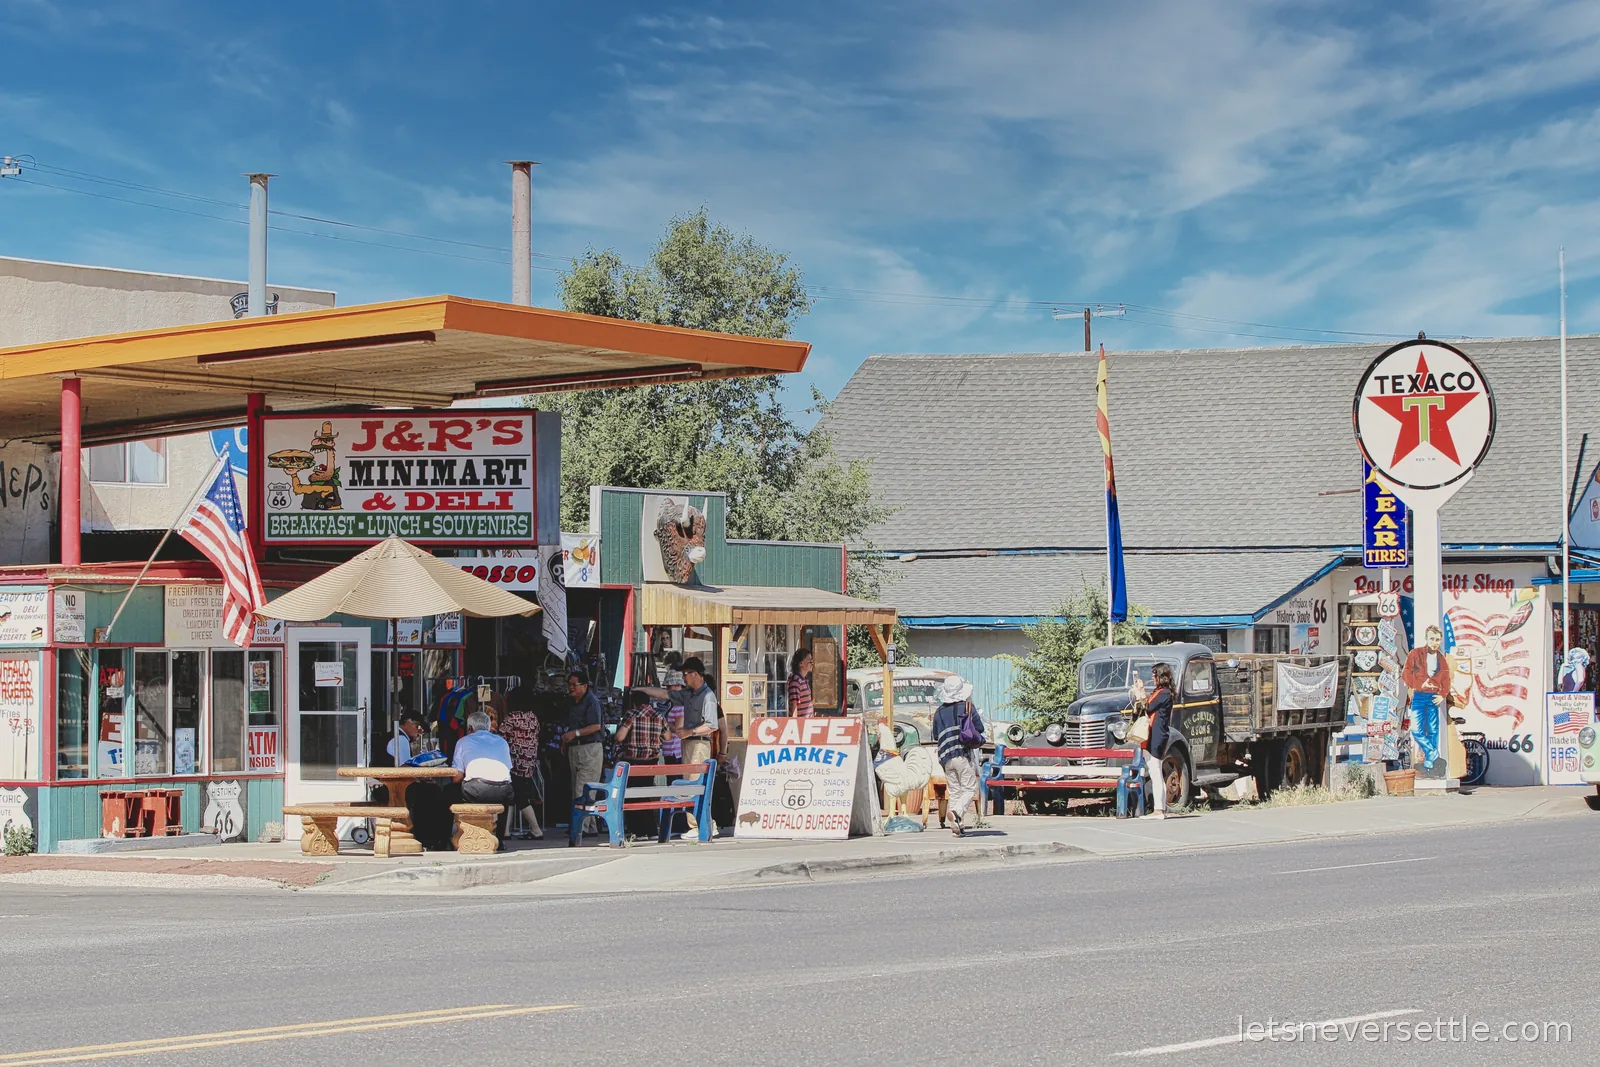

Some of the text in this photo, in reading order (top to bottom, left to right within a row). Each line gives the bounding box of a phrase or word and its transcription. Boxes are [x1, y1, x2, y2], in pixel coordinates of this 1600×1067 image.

[1374, 371, 1475, 394] TEXACO
[352, 419, 525, 452] J&R'S
[349, 458, 528, 487] MINIMART
[272, 496, 286, 506] 66
[362, 491, 514, 511] & DELI
[270, 515, 529, 536] BREAKFAST LUNCH SOUVENIRS
[1366, 549, 1406, 562] TIRES
[168, 587, 190, 596] FRESH
[190, 586, 212, 596] FRUITS
[1474, 574, 1514, 598] Shop
[22, 592, 32, 602] TO
[34, 592, 45, 602] GO
[66, 594, 76, 606] NO
[190, 598, 208, 606] FRESH
[211, 598, 224, 606] EGG
[22, 606, 38, 614] DELI
[1314, 599, 1328, 624] 66
[1381, 599, 1396, 614] 66
[191, 631, 212, 640] CHEESE
[757, 718, 854, 744] CAFE
[248, 732, 276, 755] ATM
[1508, 734, 1534, 753] 66
[1550, 736, 1577, 744] Made in
[757, 746, 848, 768] MARKET
[1551, 746, 1583, 772] US
[750, 778, 776, 786] COFFEE
[823, 778, 850, 786] SNACKS
[211, 788, 237, 797] HISTORIC
[740, 798, 780, 806] SANDWICHES
[788, 794, 806, 806] 66
[812, 799, 850, 807] GROCERIES
[214, 810, 234, 834] 66
[762, 814, 850, 830] BUFFALO BURGERS
